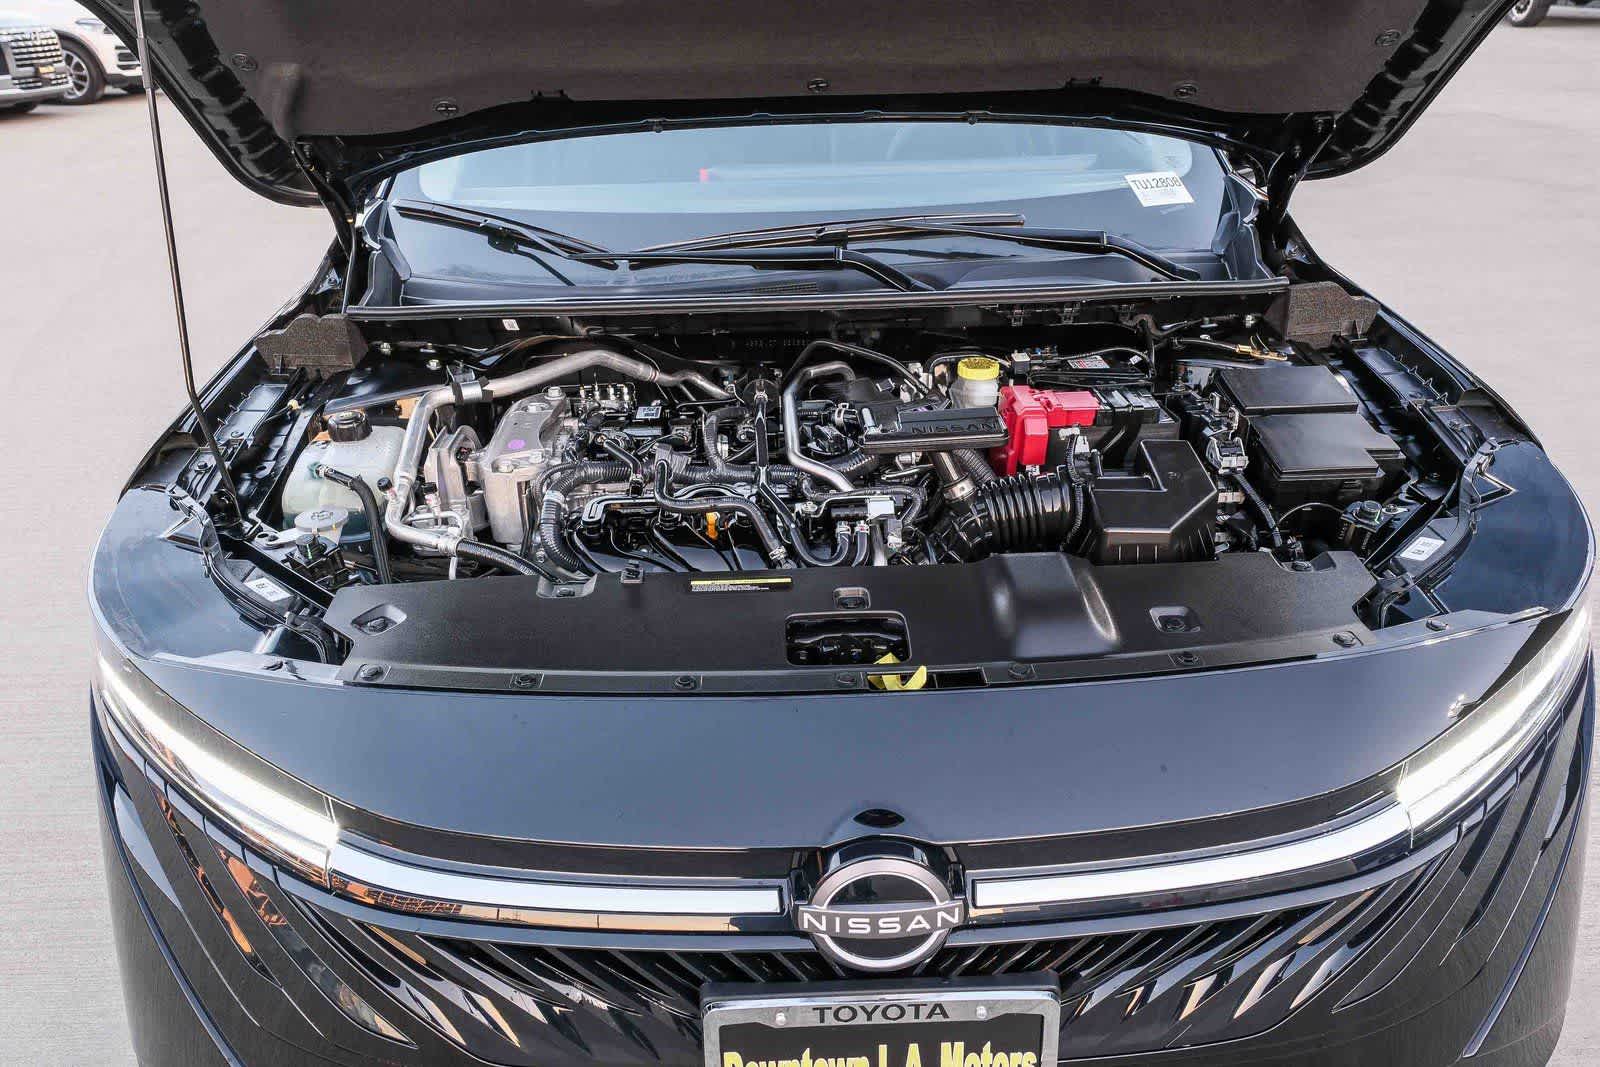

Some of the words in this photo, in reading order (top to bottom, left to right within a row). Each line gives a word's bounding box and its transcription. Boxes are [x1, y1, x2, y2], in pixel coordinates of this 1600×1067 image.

[912, 422, 998, 434] NISSAN
[803, 907, 960, 934] NISSAN
[812, 1003, 950, 1024] TOYOTA
